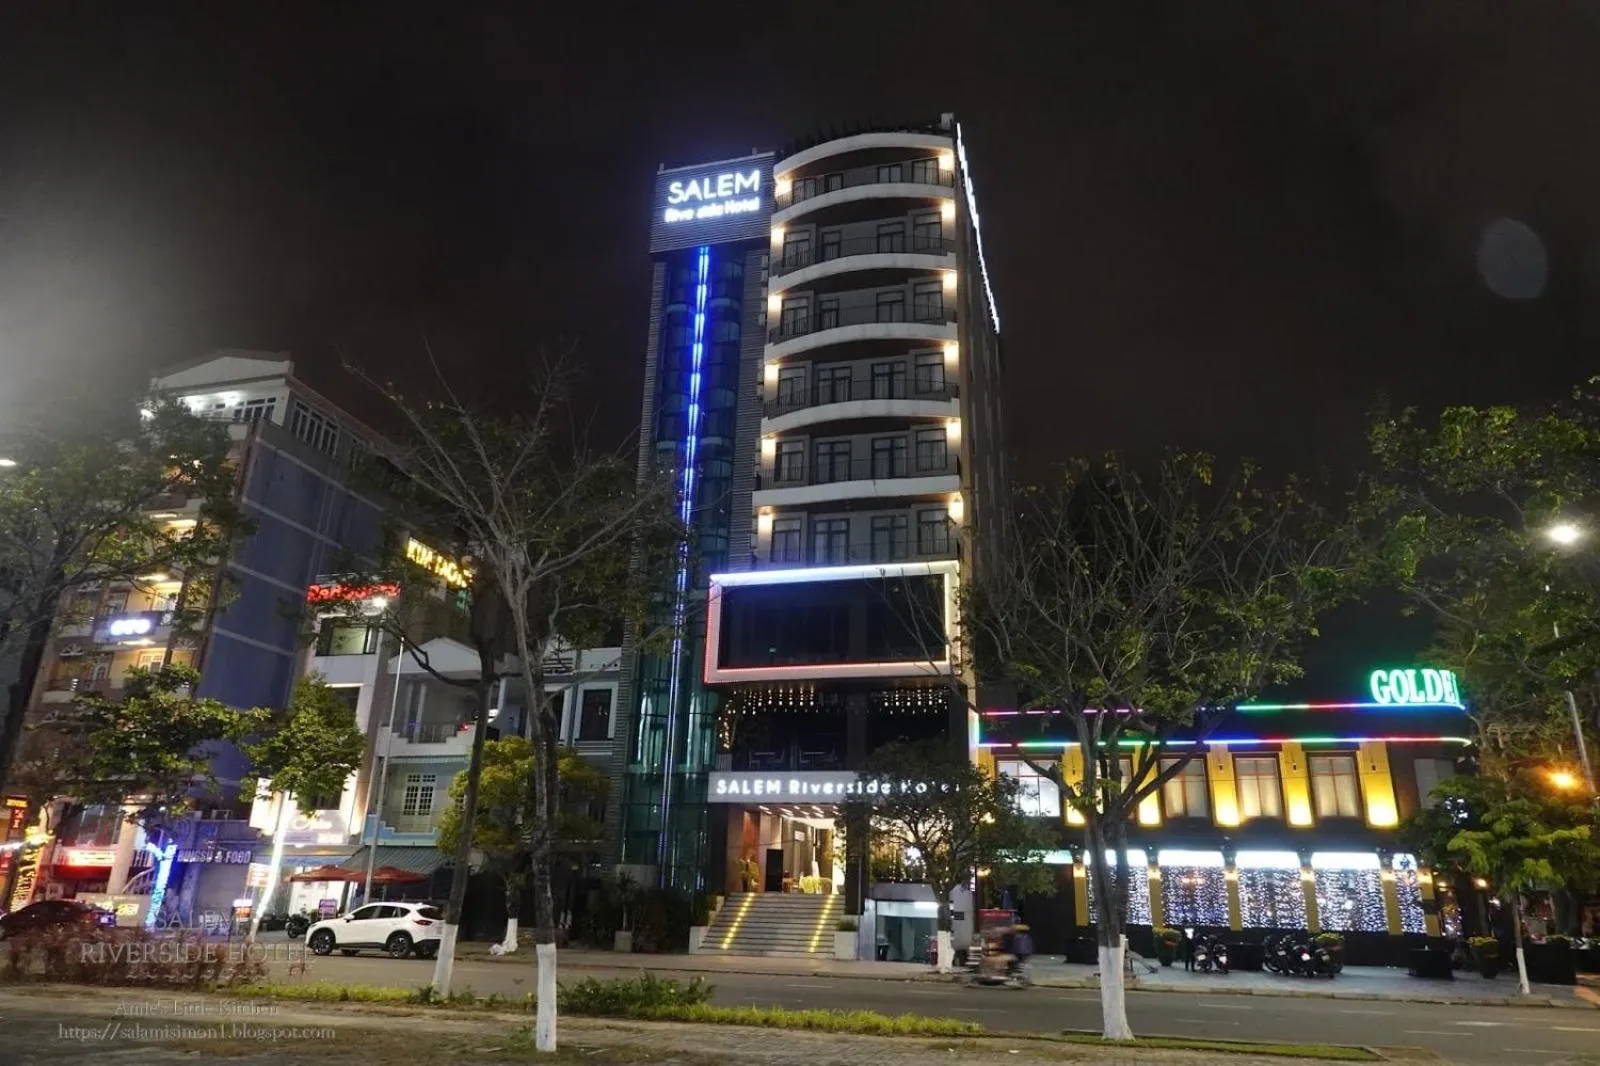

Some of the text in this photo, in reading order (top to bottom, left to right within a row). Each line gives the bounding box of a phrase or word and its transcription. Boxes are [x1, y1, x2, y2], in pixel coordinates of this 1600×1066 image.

[667, 169, 760, 204] SALEM
[716, 779, 781, 794] SALEM
[789, 779, 891, 794] Riverside
[225, 850, 252, 863] FOOD
